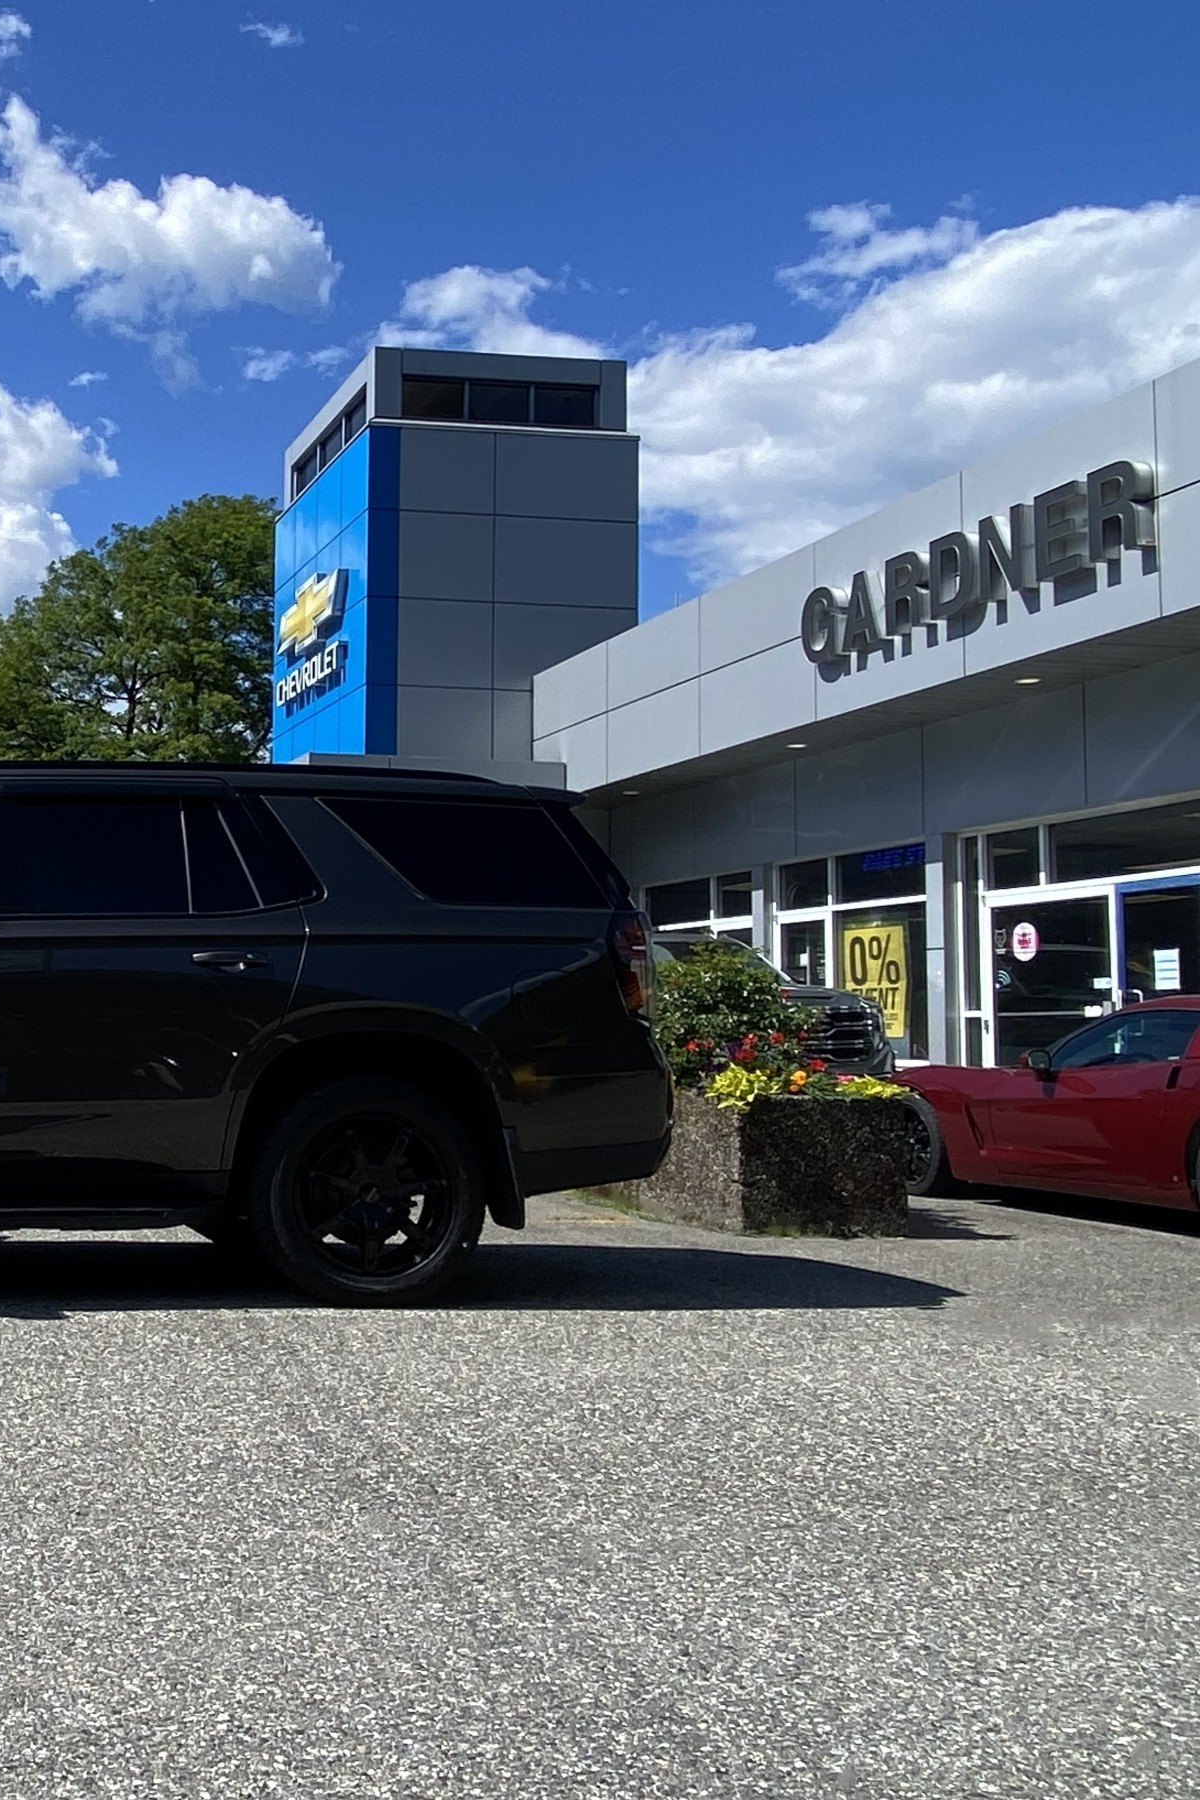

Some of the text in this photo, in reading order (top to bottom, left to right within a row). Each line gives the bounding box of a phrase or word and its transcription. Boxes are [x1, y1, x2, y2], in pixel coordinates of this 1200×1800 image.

[802, 461, 1156, 664] GARDNER
[276, 641, 339, 707] CHEVROLET
[850, 934, 900, 985] 0%
